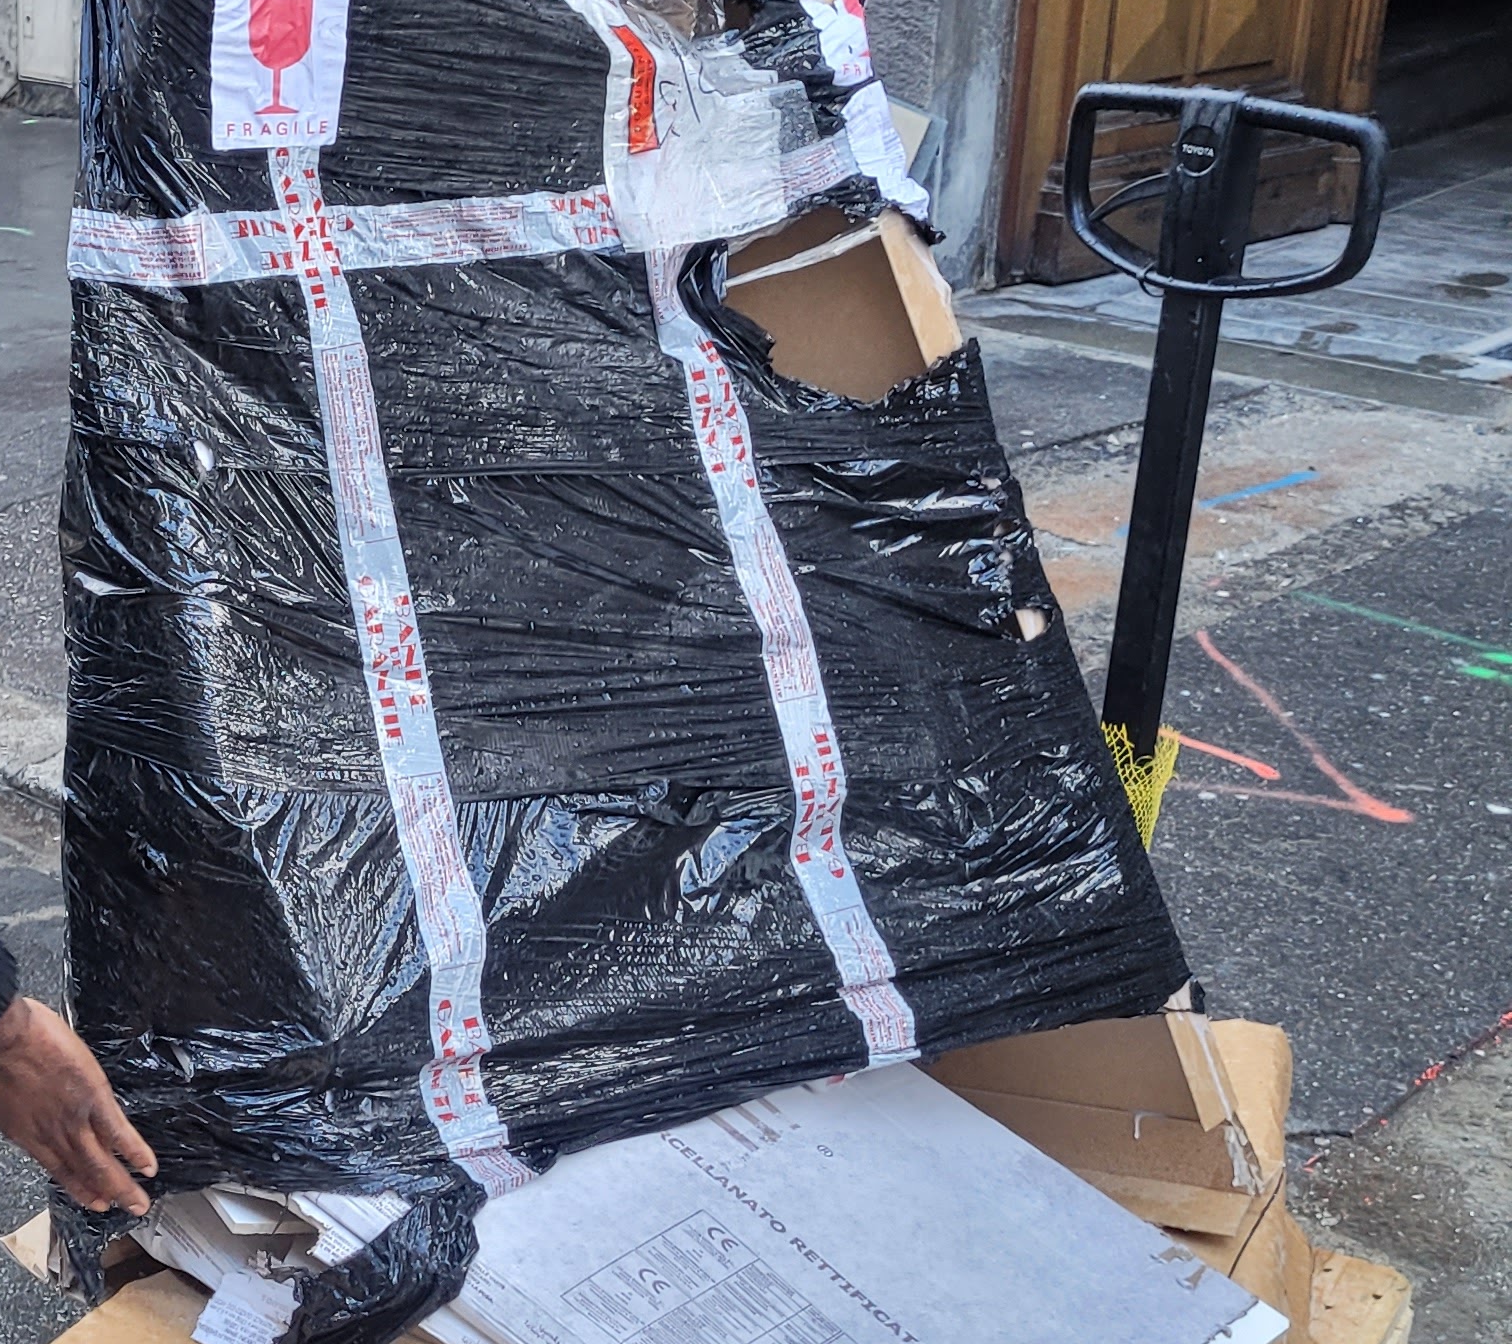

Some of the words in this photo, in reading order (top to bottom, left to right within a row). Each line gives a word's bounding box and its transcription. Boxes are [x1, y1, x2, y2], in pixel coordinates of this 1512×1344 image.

[226, 120, 329, 137] FRAGILE
[1182, 143, 1214, 157] TOYOTA
[394, 593, 429, 716] BANDE
[794, 758, 817, 865] BANDE
[707, 1226, 739, 1253] CE
[638, 1267, 671, 1295] CE
